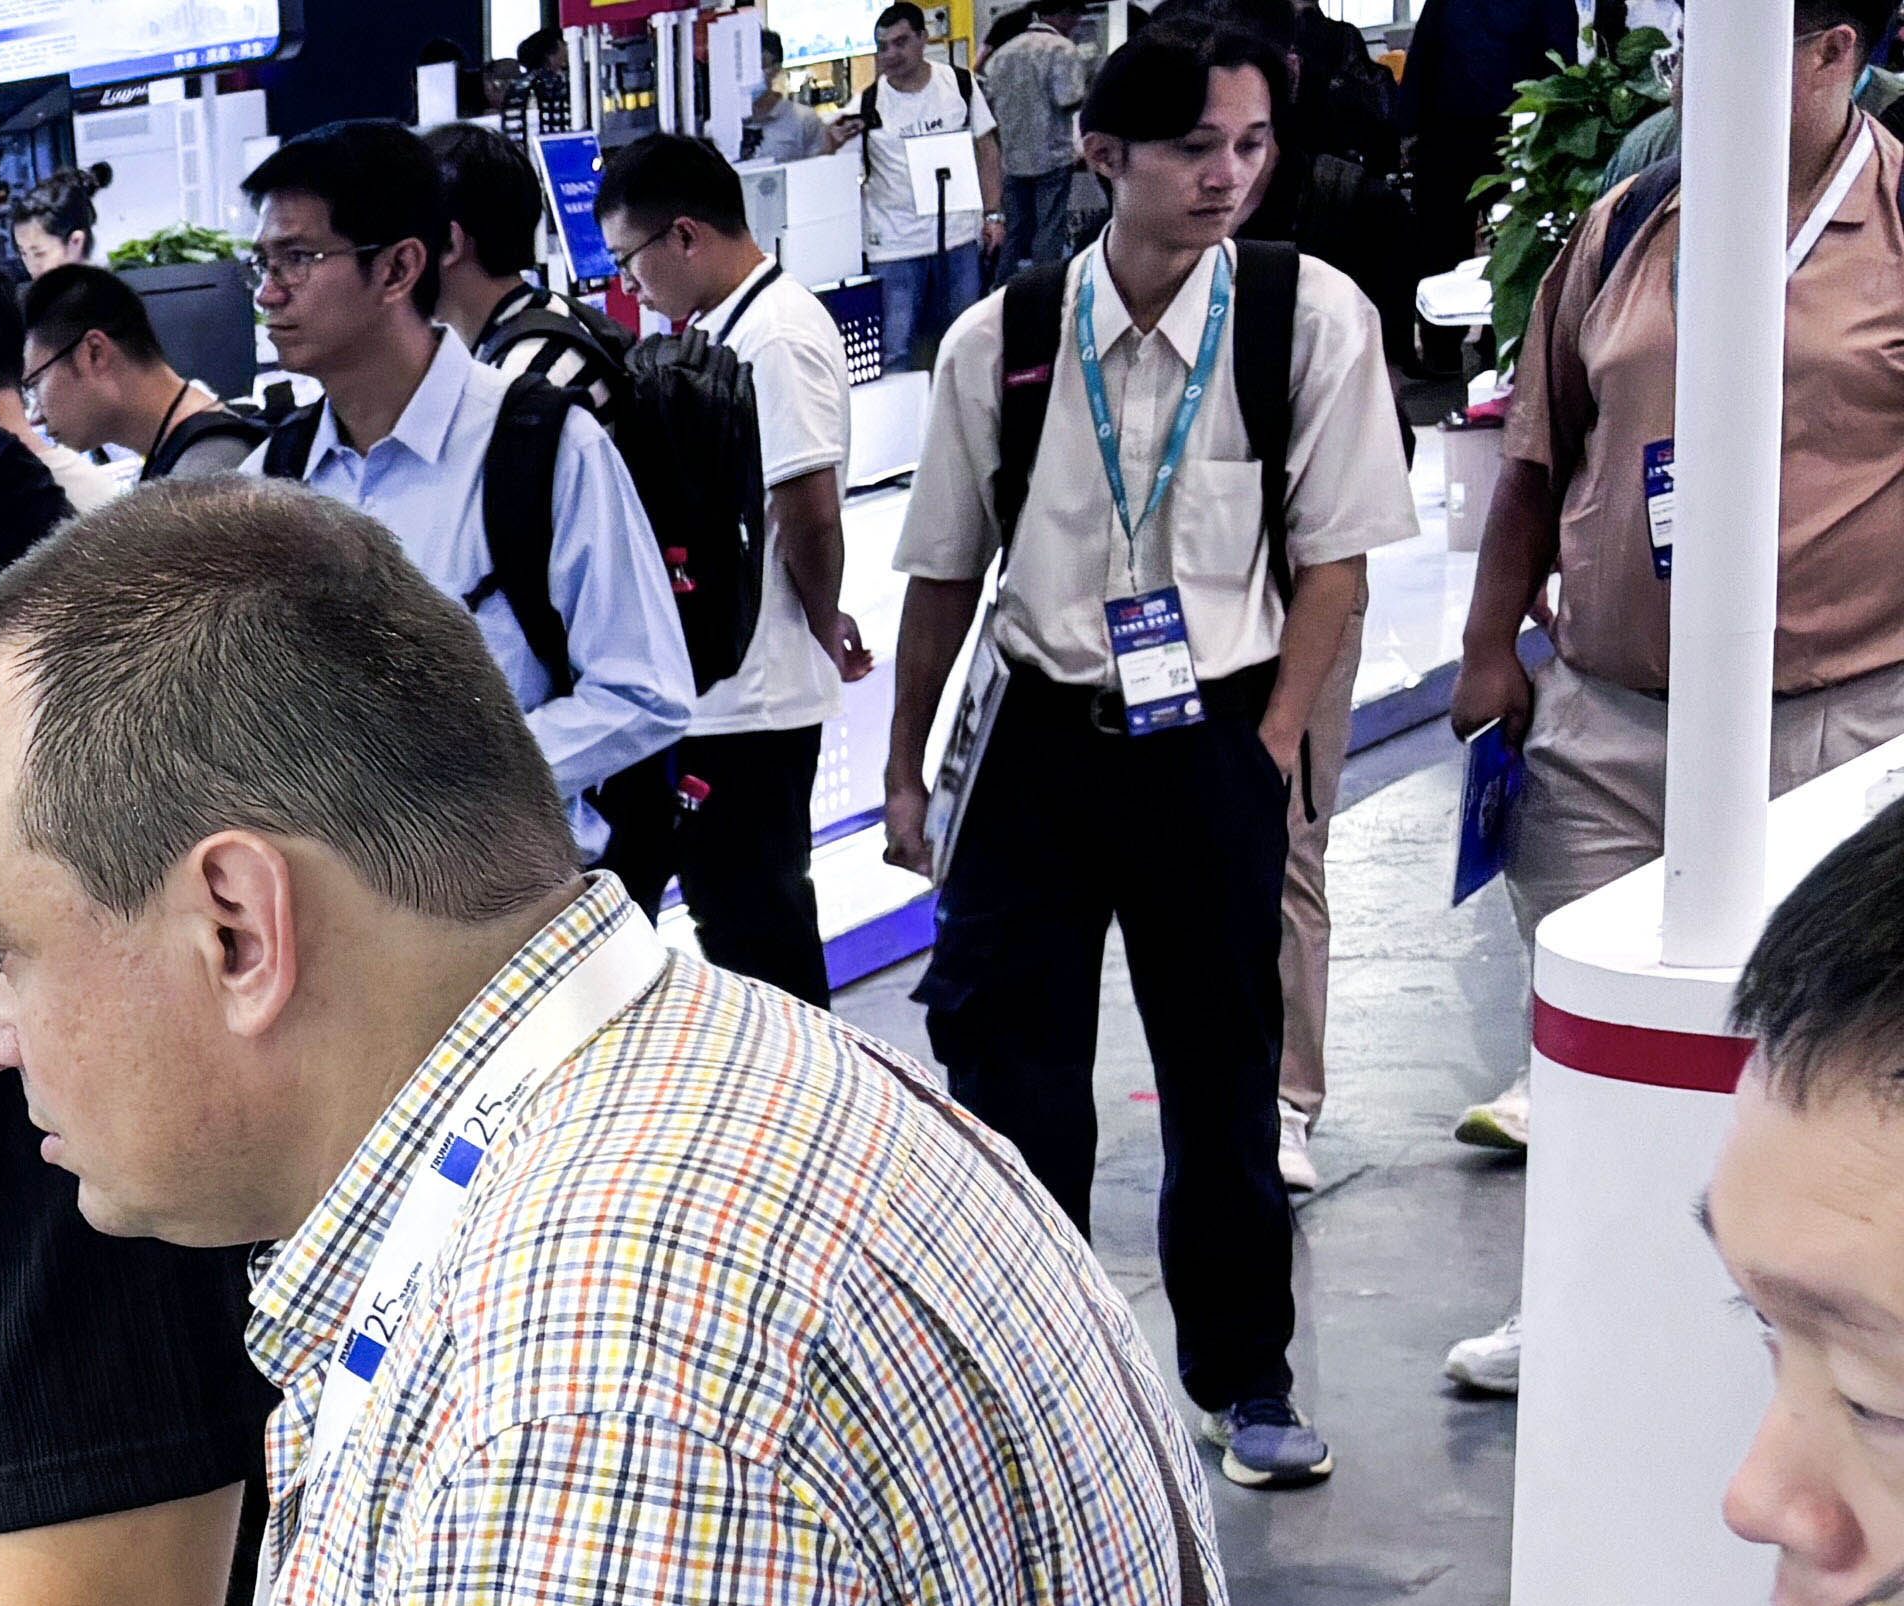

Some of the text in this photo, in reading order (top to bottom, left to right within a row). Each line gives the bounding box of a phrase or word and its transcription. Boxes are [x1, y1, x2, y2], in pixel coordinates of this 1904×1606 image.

[463, 1092, 503, 1147] 25
[430, 1131, 456, 1171] TRUMPF
[363, 1291, 398, 1344] 25
